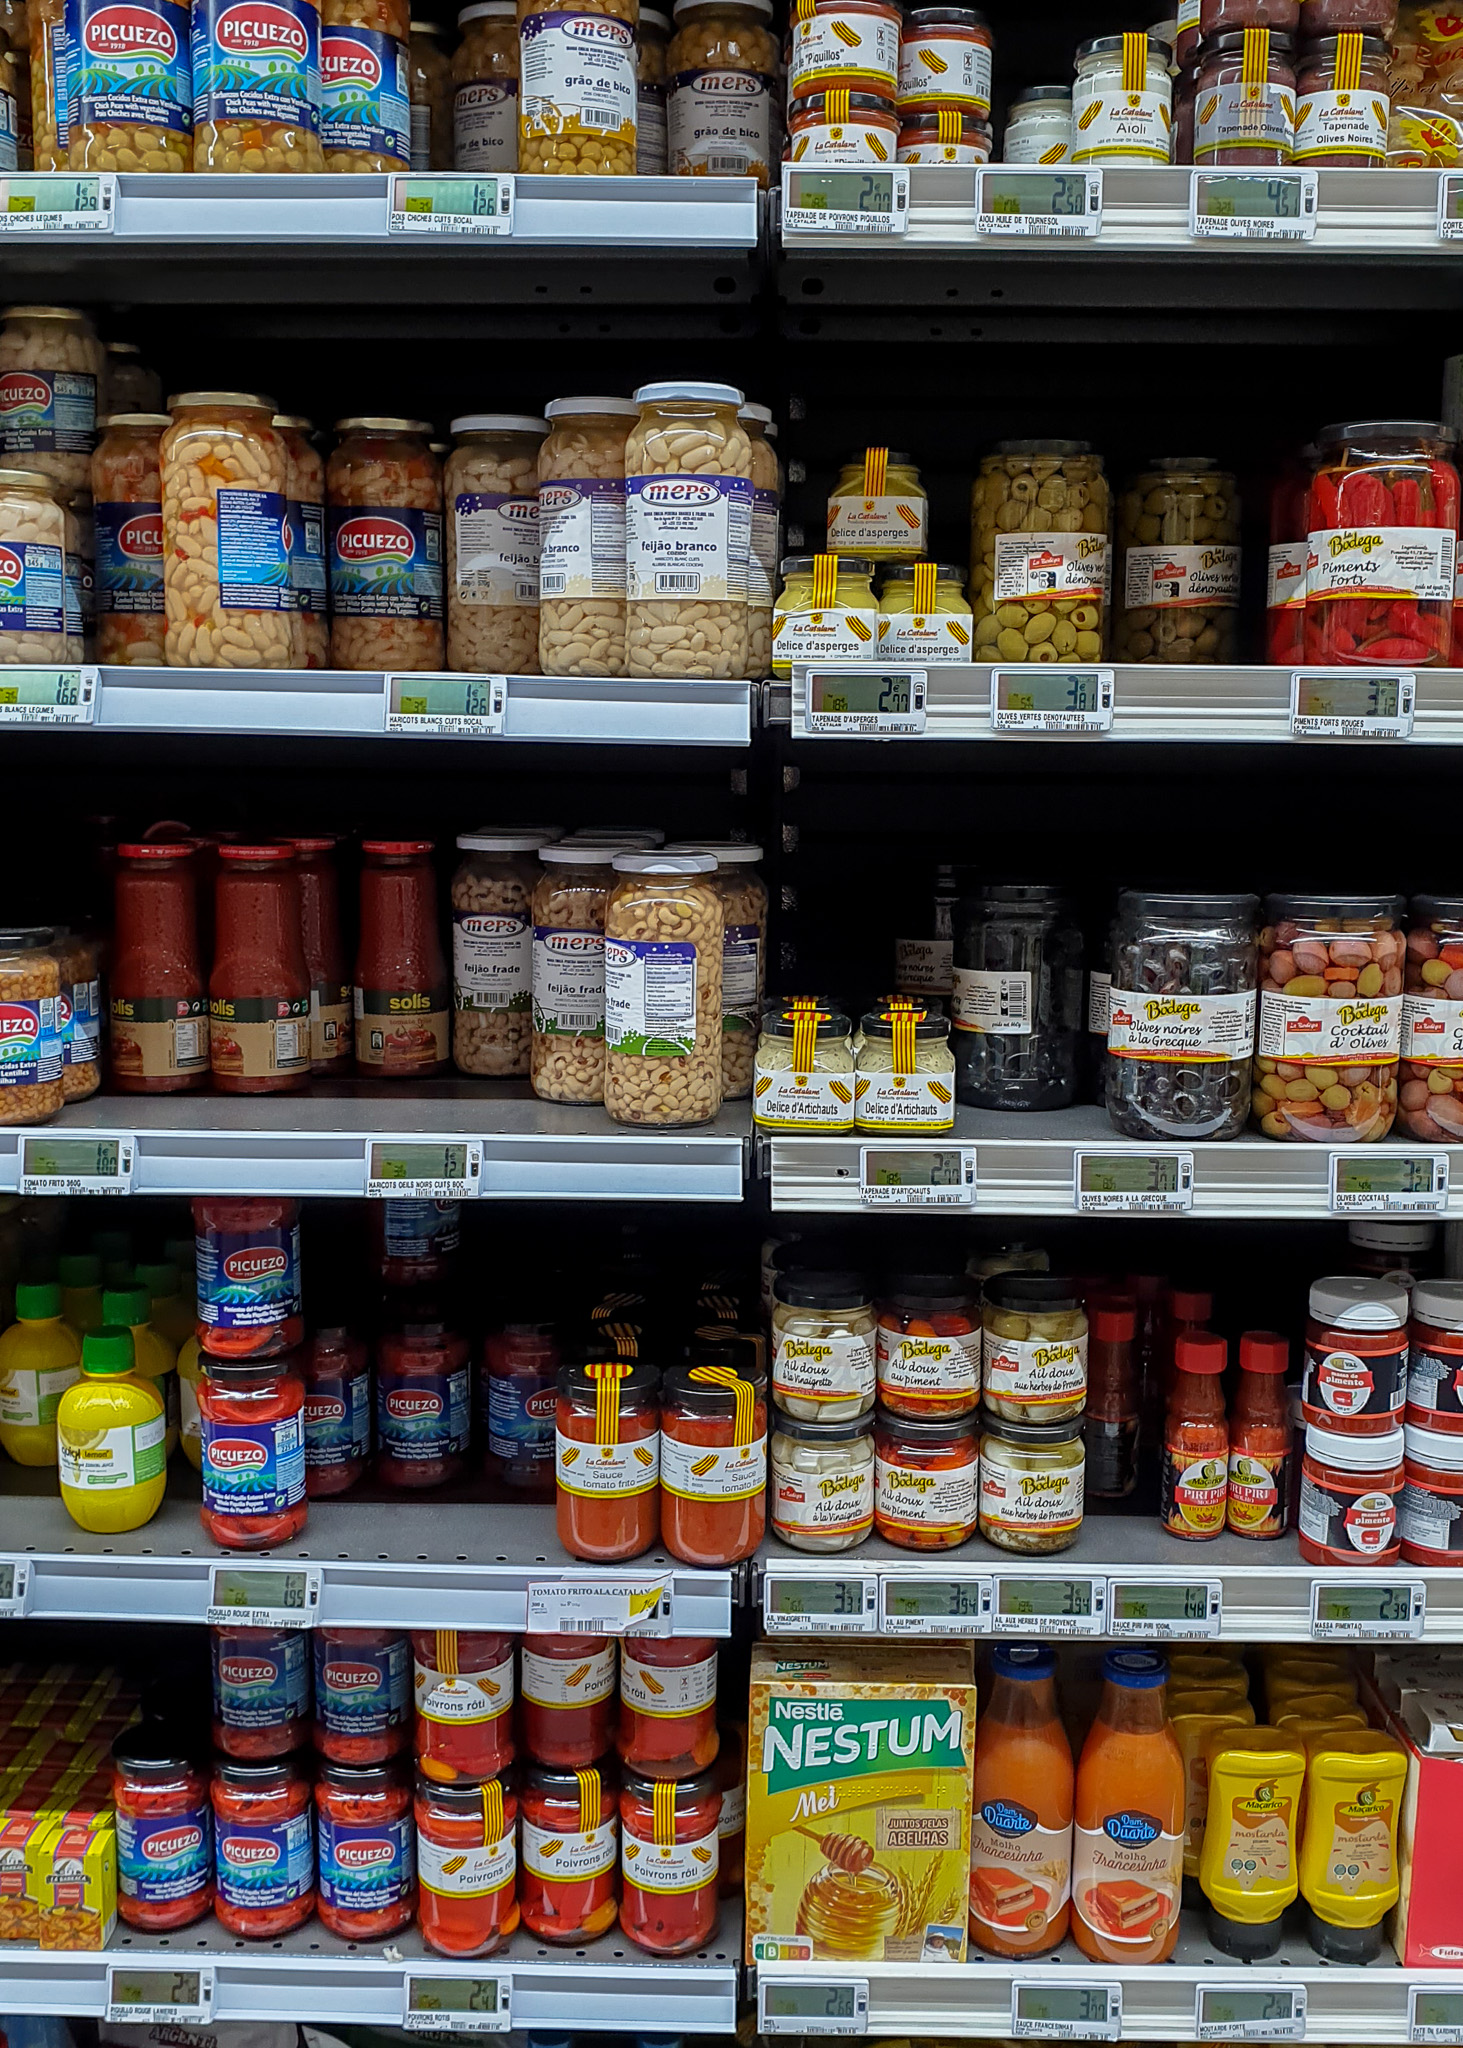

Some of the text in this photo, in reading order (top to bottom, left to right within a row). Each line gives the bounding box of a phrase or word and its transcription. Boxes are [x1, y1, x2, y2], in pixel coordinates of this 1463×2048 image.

[91, 25, 172, 48] PICUEZO
[223, 20, 302, 45] PICUEZO
[565, 76, 631, 95] grão de bico
[701, 74, 757, 93] meps
[694, 127, 760, 138] grão de bico
[1217, 124, 1282, 134] Tapenade Olives
[1323, 122, 1370, 132] Tapenade
[1316, 135, 1374, 144] Olives Noires
[392, 213, 472, 224] POIS CHICHES CUITS BOCAL
[785, 211, 890, 223] TAPENADE DE POIVRONS PIQUILLOS
[1198, 217, 1274, 229] TAPENADE OLIVES NOIRES
[649, 484, 711, 502] meps
[831, 527, 908, 539] Delice d'asperges
[341, 534, 409, 550] PICUEZO
[547, 543, 579, 554] branco
[641, 540, 717, 553] feijão branco
[1330, 533, 1384, 555] Bodega
[499, 552, 531, 565] feijão
[1322, 562, 1381, 574] Piments
[1330, 574, 1367, 586] Forts
[777, 640, 859, 652] Delice d'asperges
[880, 644, 959, 656] Delice d'asperges
[390, 715, 418, 723] HARICOTS
[420, 716, 442, 724] BLANCS
[812, 715, 841, 723] TAPENADE
[998, 713, 1085, 721] OLIVES VERTES DENOYAUTEES
[1294, 718, 1318, 726] PIMENTS
[466, 919, 522, 933] meps
[464, 964, 520, 975] feijão frade
[610, 997, 630, 1009] frade
[1146, 1000, 1201, 1021] Bodega
[1339, 1004, 1388, 1025] Bodega
[1129, 1020, 1202, 1035] Olives noires
[1331, 1024, 1389, 1037] Cocktail
[766, 1101, 838, 1115] Delice d'Artichauts
[865, 1102, 937, 1115] Delice d'Artichauts
[24, 1179, 47, 1187] TOMATO
[861, 1187, 890, 1195] TAPENADE
[230, 1256, 285, 1272] PICUEZO
[784, 1342, 833, 1362] Bodega
[900, 1341, 951, 1362] Bodega
[1034, 1346, 1080, 1368] Bodega
[784, 1360, 829, 1375] Ail doux
[892, 1359, 939, 1374] Ail doux
[1029, 1367, 1075, 1379] Ail doux
[891, 1373, 942, 1387] au piment
[1326, 1376, 1363, 1386] pimento
[390, 1399, 439, 1410] PICUEZO
[211, 1448, 263, 1464] PICUEZO
[592, 1470, 623, 1479] Sauce
[731, 1472, 757, 1481] Sauce
[888, 1471, 936, 1489] Bodega
[583, 1478, 636, 1489] tomato frito
[819, 1474, 865, 1497] Bodega
[1021, 1475, 1070, 1497] Bodega
[881, 1489, 924, 1506] Ail doux
[1245, 1489, 1268, 1499] PIRI
[815, 1499, 861, 1512] Ail doux
[1015, 1496, 1063, 1508] Ail doux
[1355, 1517, 1390, 1526] pimento
[532, 1588, 566, 1597] TOMATO
[568, 1588, 592, 1596] FRITO
[208, 1609, 270, 1619] PIQUILLO ROUGE EXTRA
[222, 1664, 273, 1678] PICUEZO
[775, 1661, 829, 1672] NESTUM
[326, 1669, 378, 1683] PICUEZO
[763, 1711, 963, 1774] NESTUM
[790, 1787, 839, 1823] Mel
[1245, 1801, 1283, 1810] Maçarico
[1347, 1804, 1385, 1814] Maçarico
[888, 1818, 948, 1829] JUNTOS PELAS
[984, 1807, 1032, 1830] Duarte
[1108, 1819, 1156, 1840] Duarte
[1235, 1829, 1285, 1838] mostarda
[147, 1832, 199, 1851] PICUEZO
[888, 1831, 948, 1846] ABELHAS
[1338, 1832, 1387, 1843] mostarda
[225, 1844, 276, 1858] PICUEZO
[991, 1838, 1021, 1851] Molho
[339, 1847, 392, 1860] PICUEZO
[1114, 1851, 1146, 1861] Molho
[555, 1855, 599, 1868] Poivrons
[459, 1870, 504, 1884] Poivrons
[634, 1863, 698, 1880] Poivrons rôti
[408, 2013, 450, 2022] POIVRONS ROTIS
[1200, 2026, 1226, 2034] MOUTARDE
